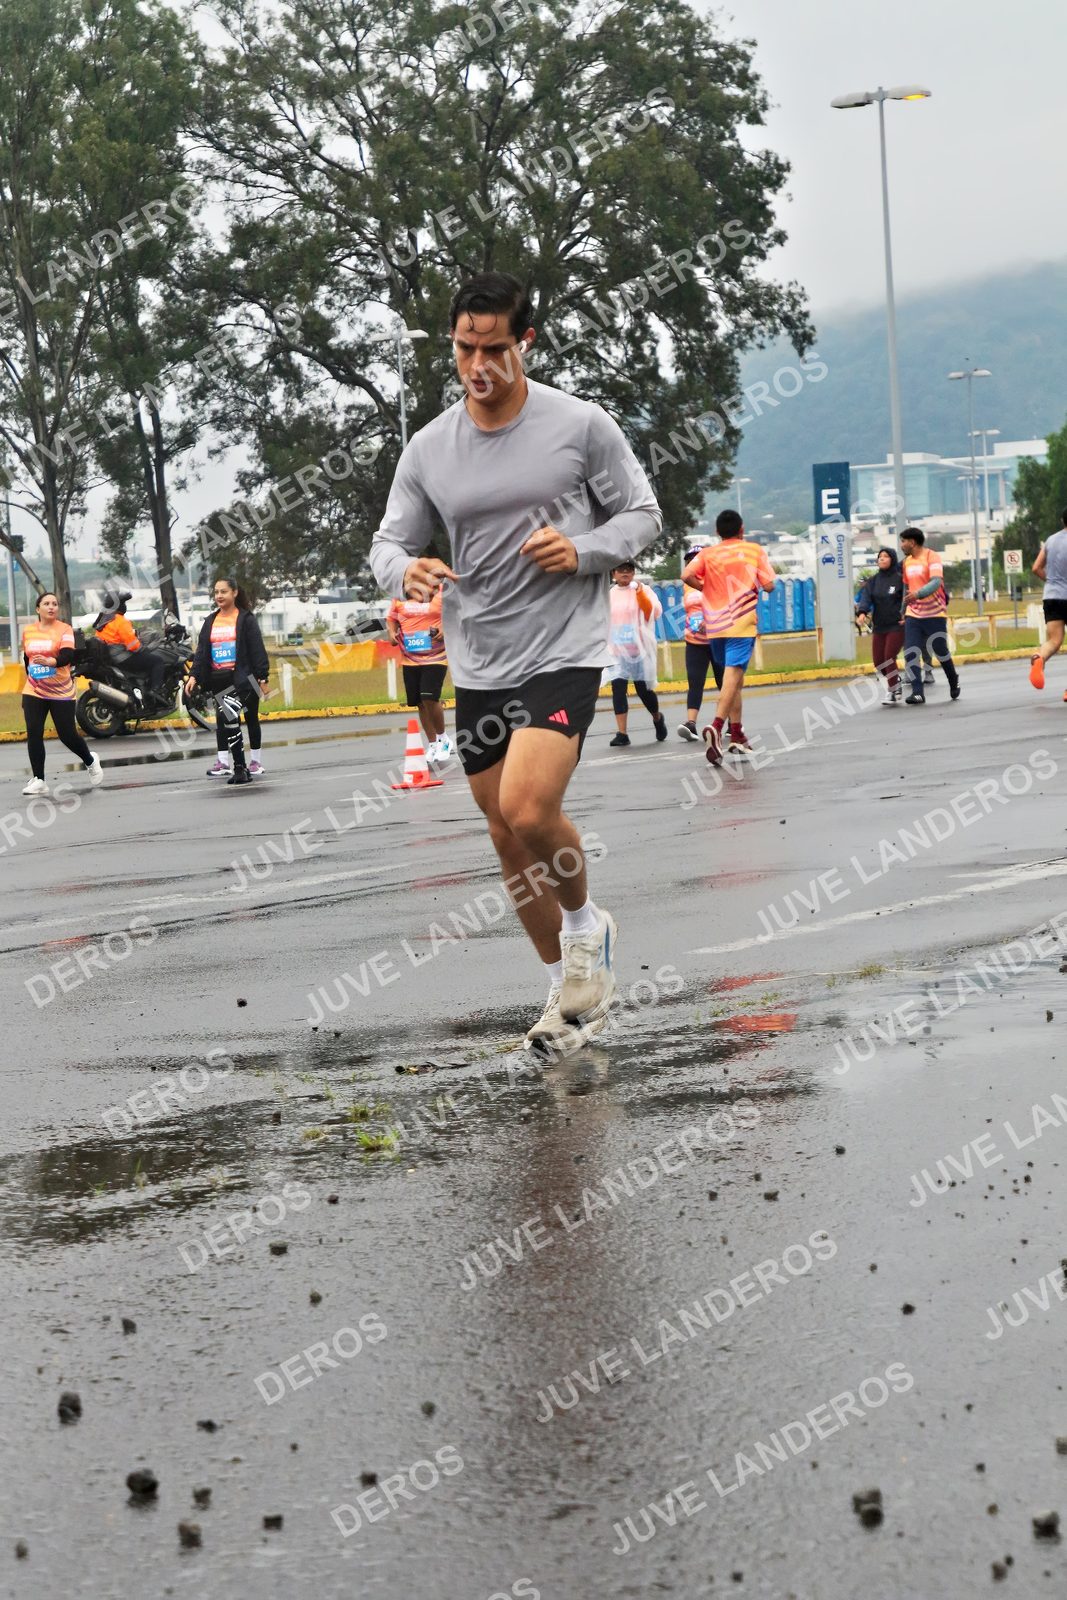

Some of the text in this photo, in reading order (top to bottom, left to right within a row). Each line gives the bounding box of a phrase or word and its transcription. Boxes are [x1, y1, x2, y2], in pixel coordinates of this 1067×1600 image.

[821, 488, 841, 515] E
[836, 534, 846, 579] General
[215, 649, 231, 658] 2581
[33, 666, 50, 674] 2583
